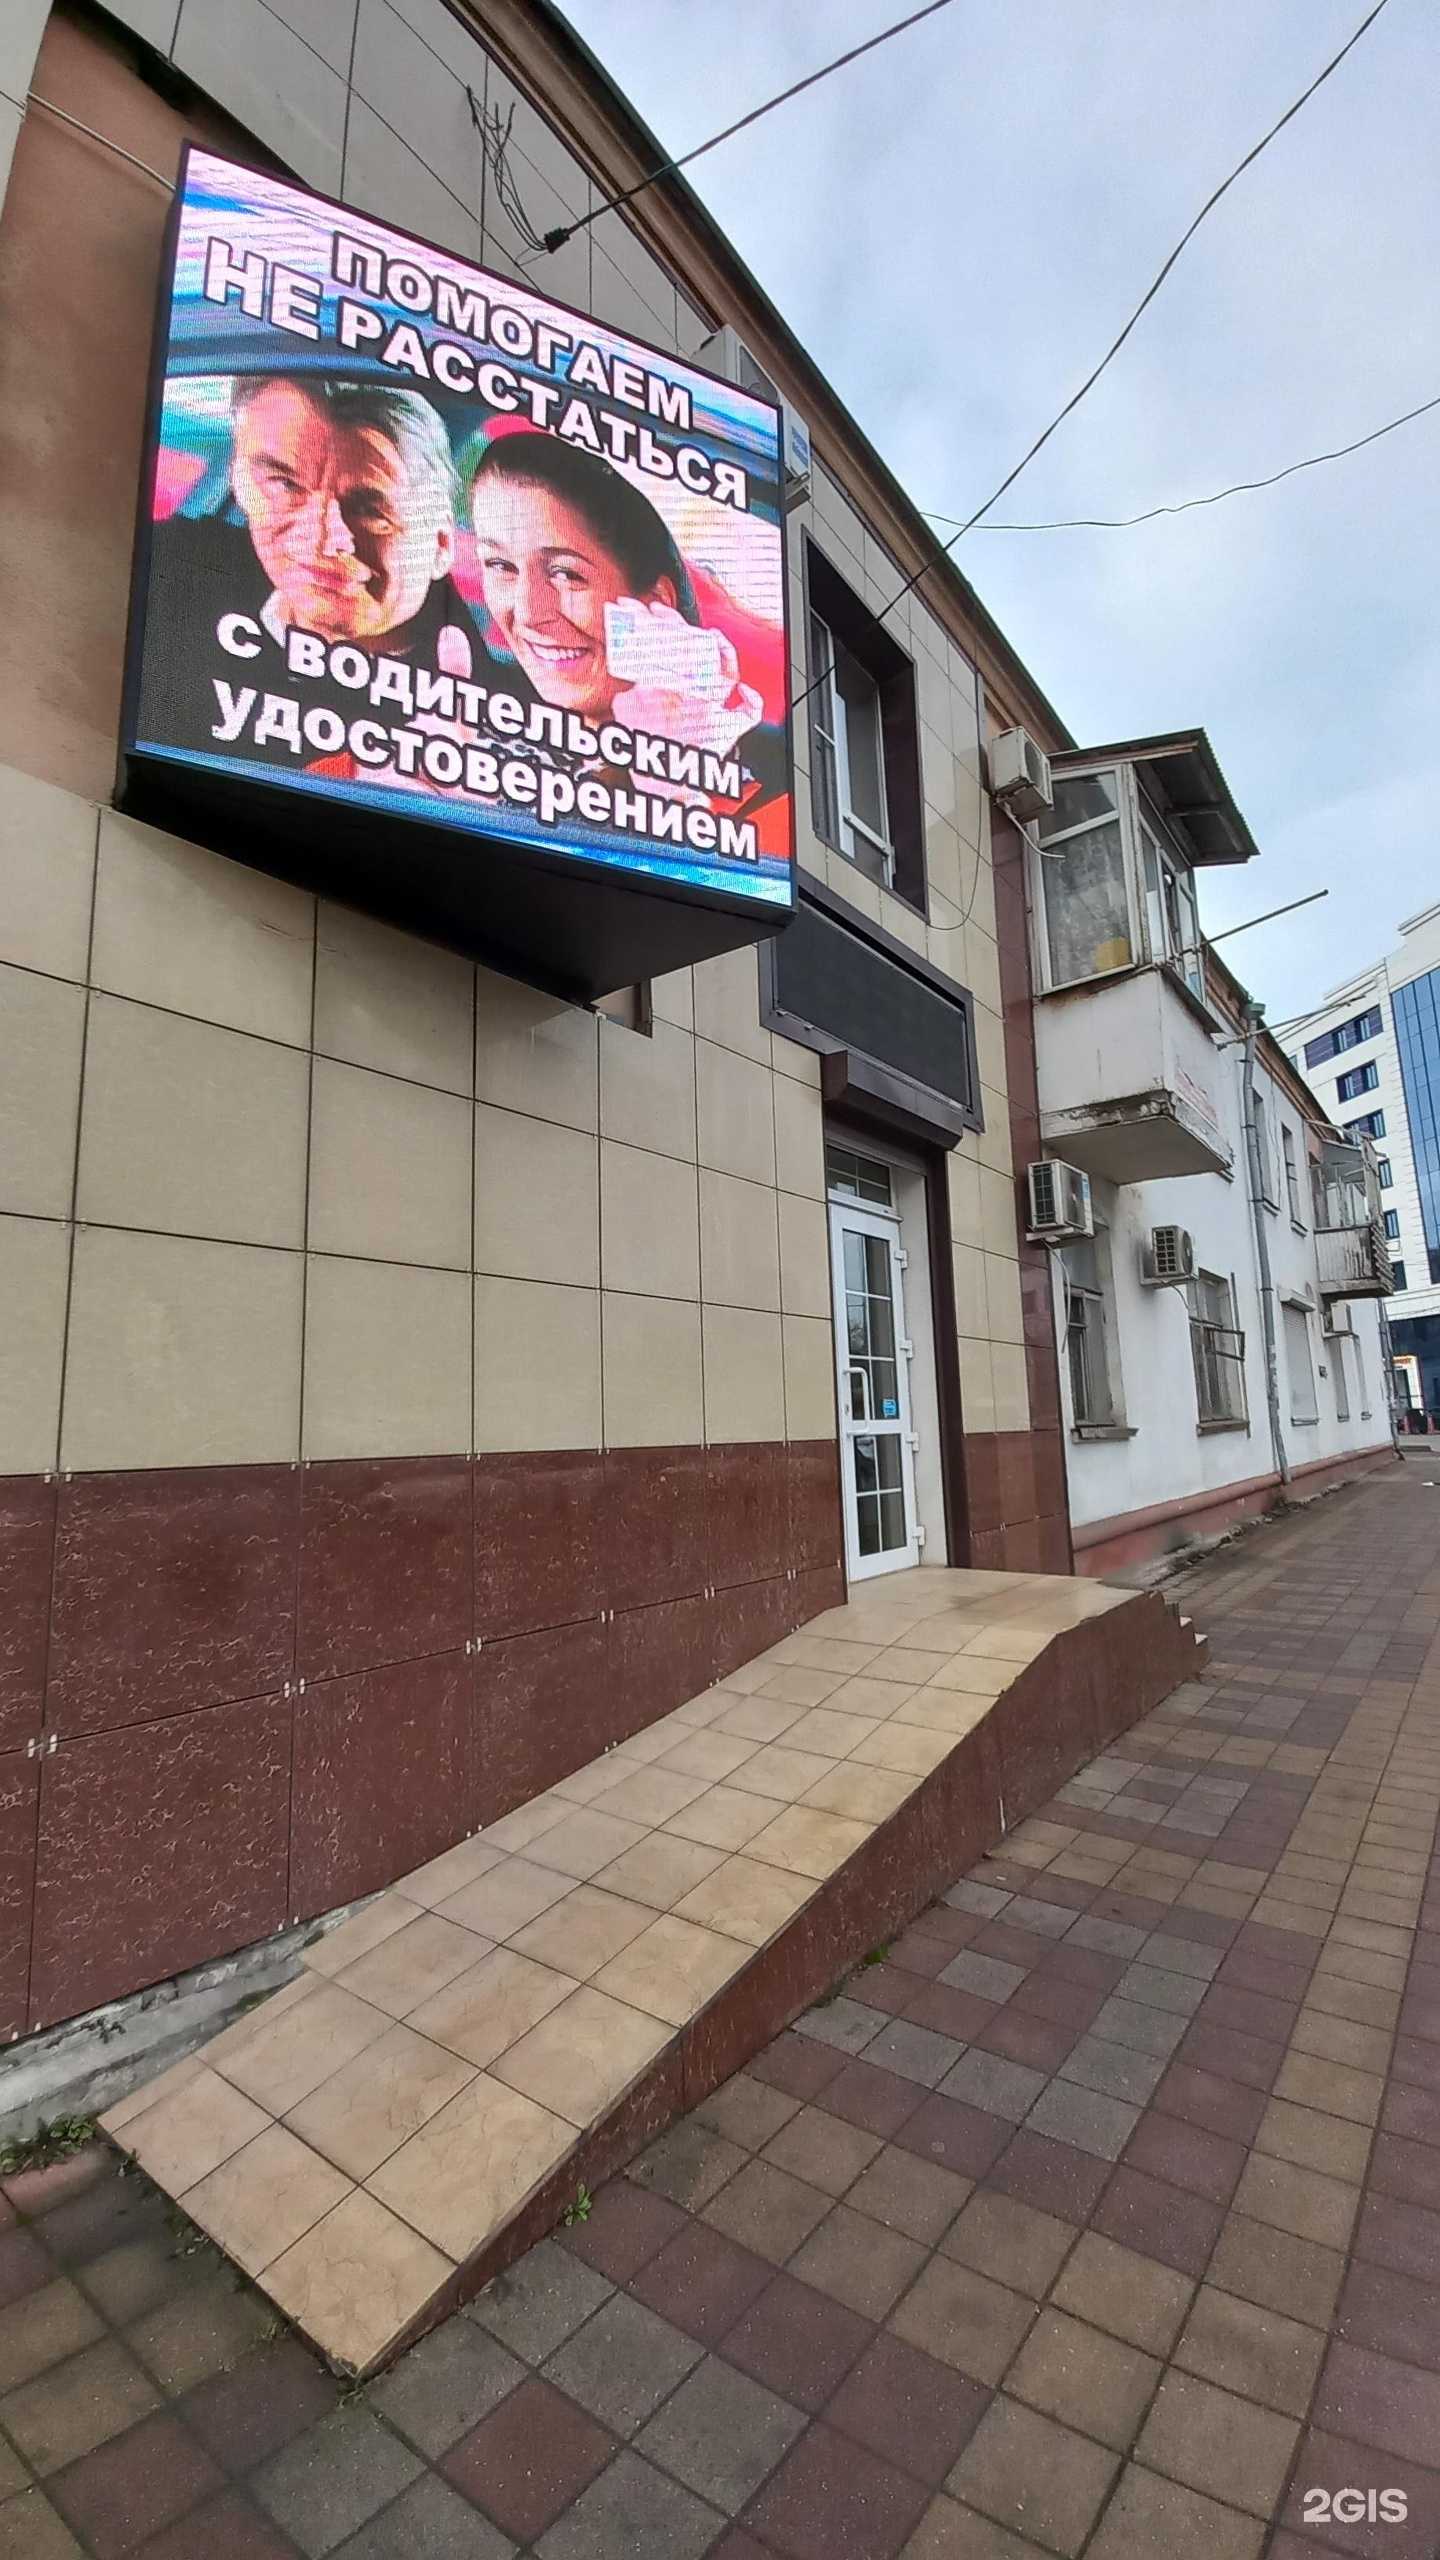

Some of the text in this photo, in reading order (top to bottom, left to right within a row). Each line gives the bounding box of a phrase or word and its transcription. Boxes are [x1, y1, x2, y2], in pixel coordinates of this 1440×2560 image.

[204, 237, 748, 511] НЕ РАССТАТЬСЯ
[333, 231, 691, 431] ПОМОГАЕМ
[210, 678, 758, 861] удостоверением
[286, 628, 741, 799] водительским
